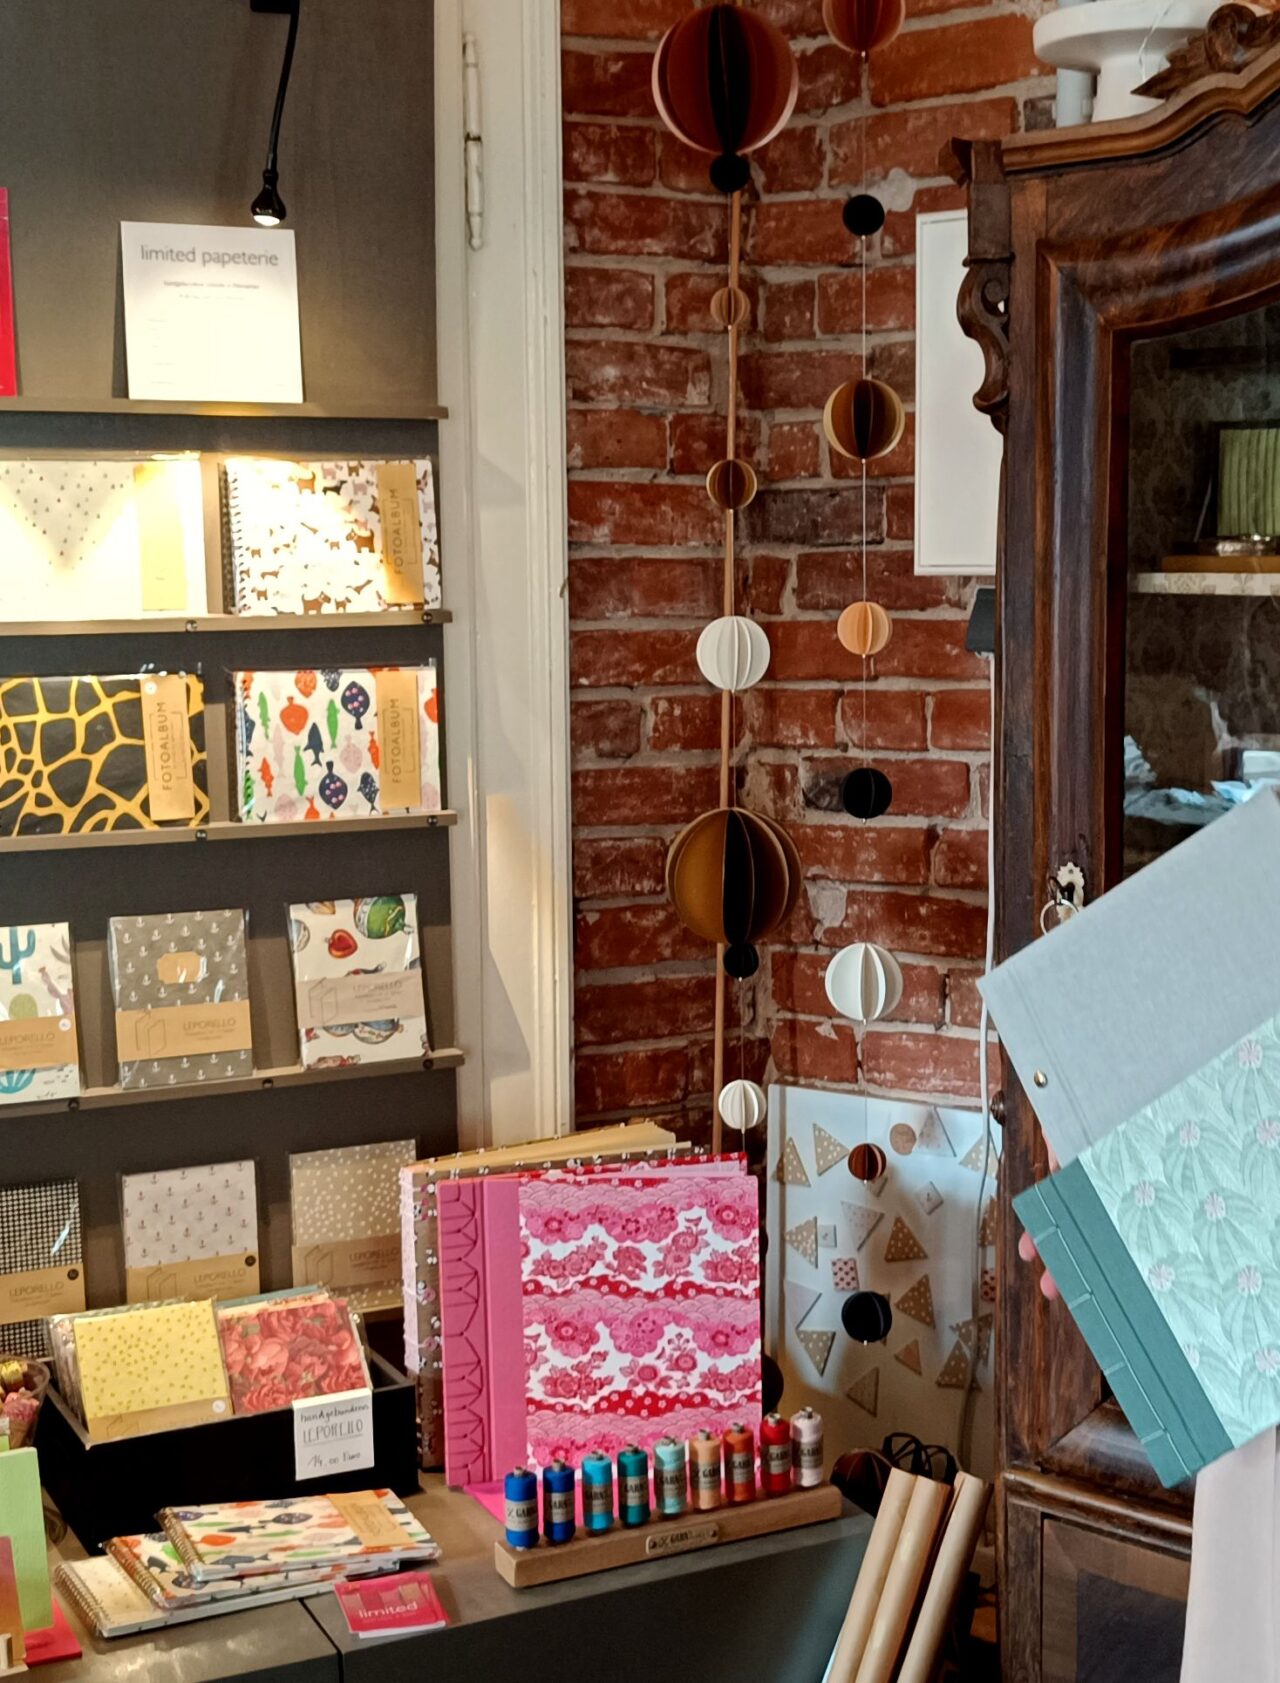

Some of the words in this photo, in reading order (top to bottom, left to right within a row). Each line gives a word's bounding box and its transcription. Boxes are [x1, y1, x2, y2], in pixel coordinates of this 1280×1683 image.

[141, 245, 196, 263] limited
[202, 250, 279, 267] papeterie
[389, 489, 404, 575] FOTOALBUM
[156, 702, 173, 791] FOTOALBUM
[389, 698, 402, 784] FOTOALBUM
[358, 1600, 418, 1618] limited
